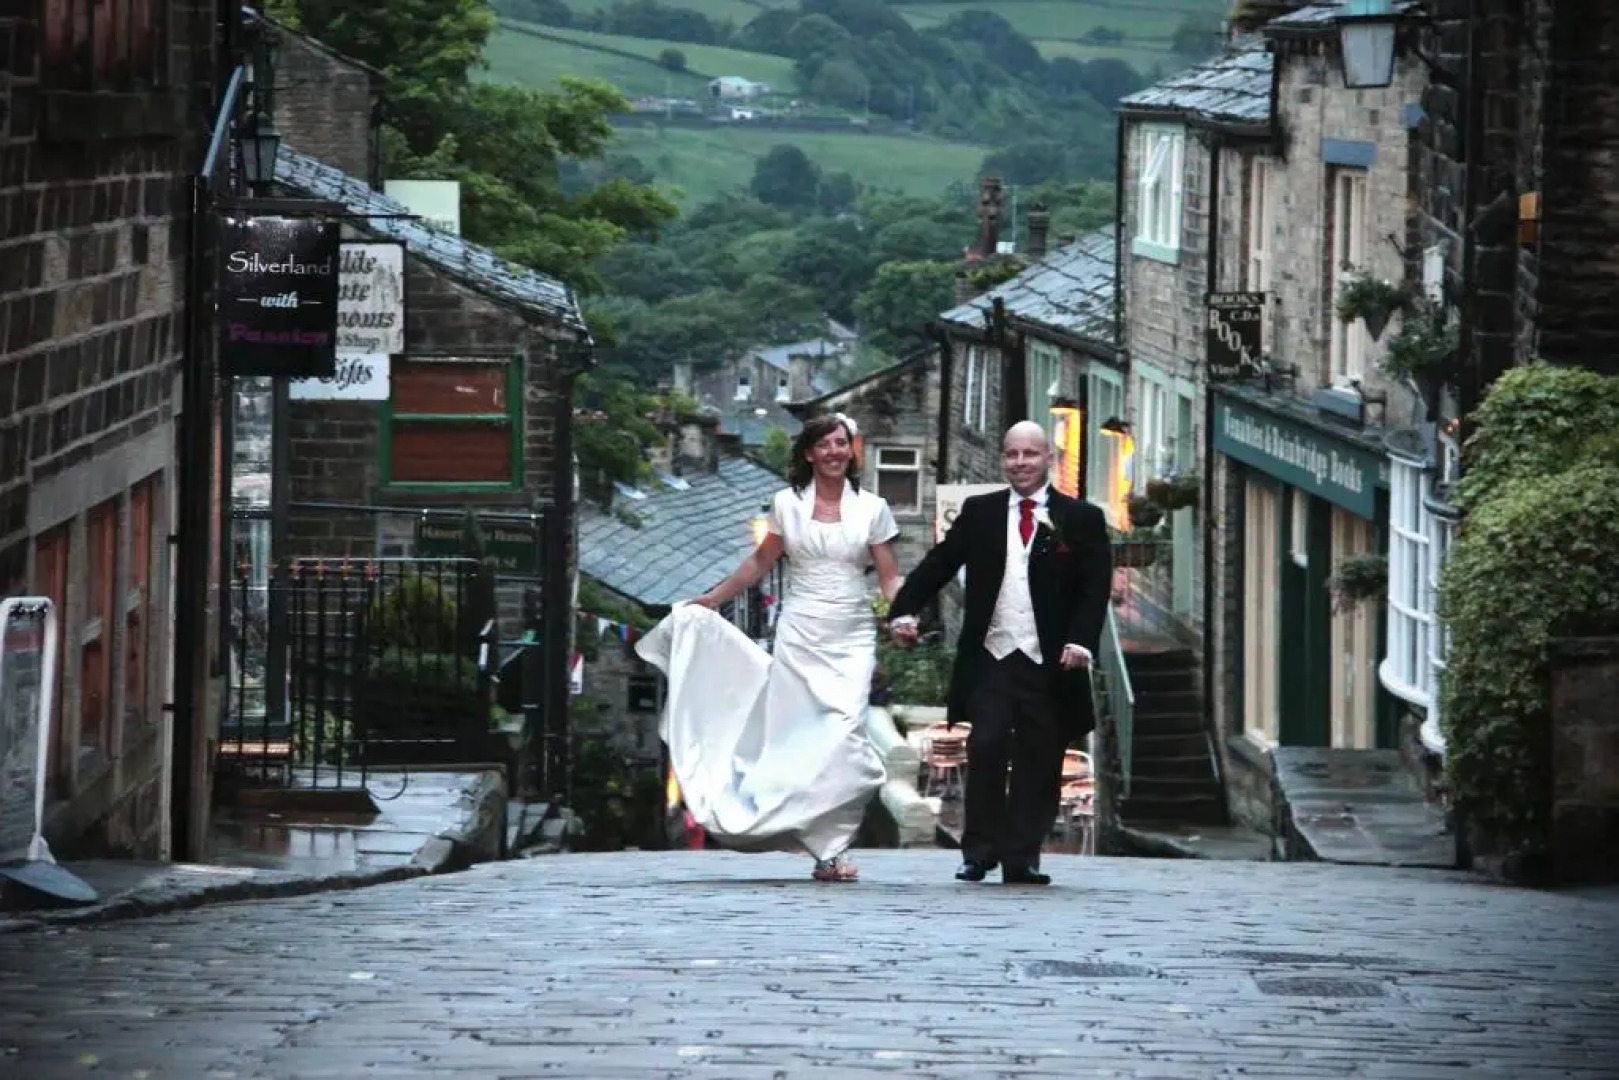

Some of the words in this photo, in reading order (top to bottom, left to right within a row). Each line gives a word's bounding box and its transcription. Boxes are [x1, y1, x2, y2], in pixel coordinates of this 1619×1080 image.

[227, 251, 331, 274] Silverland
[260, 291, 298, 308] with
[1210, 309, 1263, 376] BOOKS
